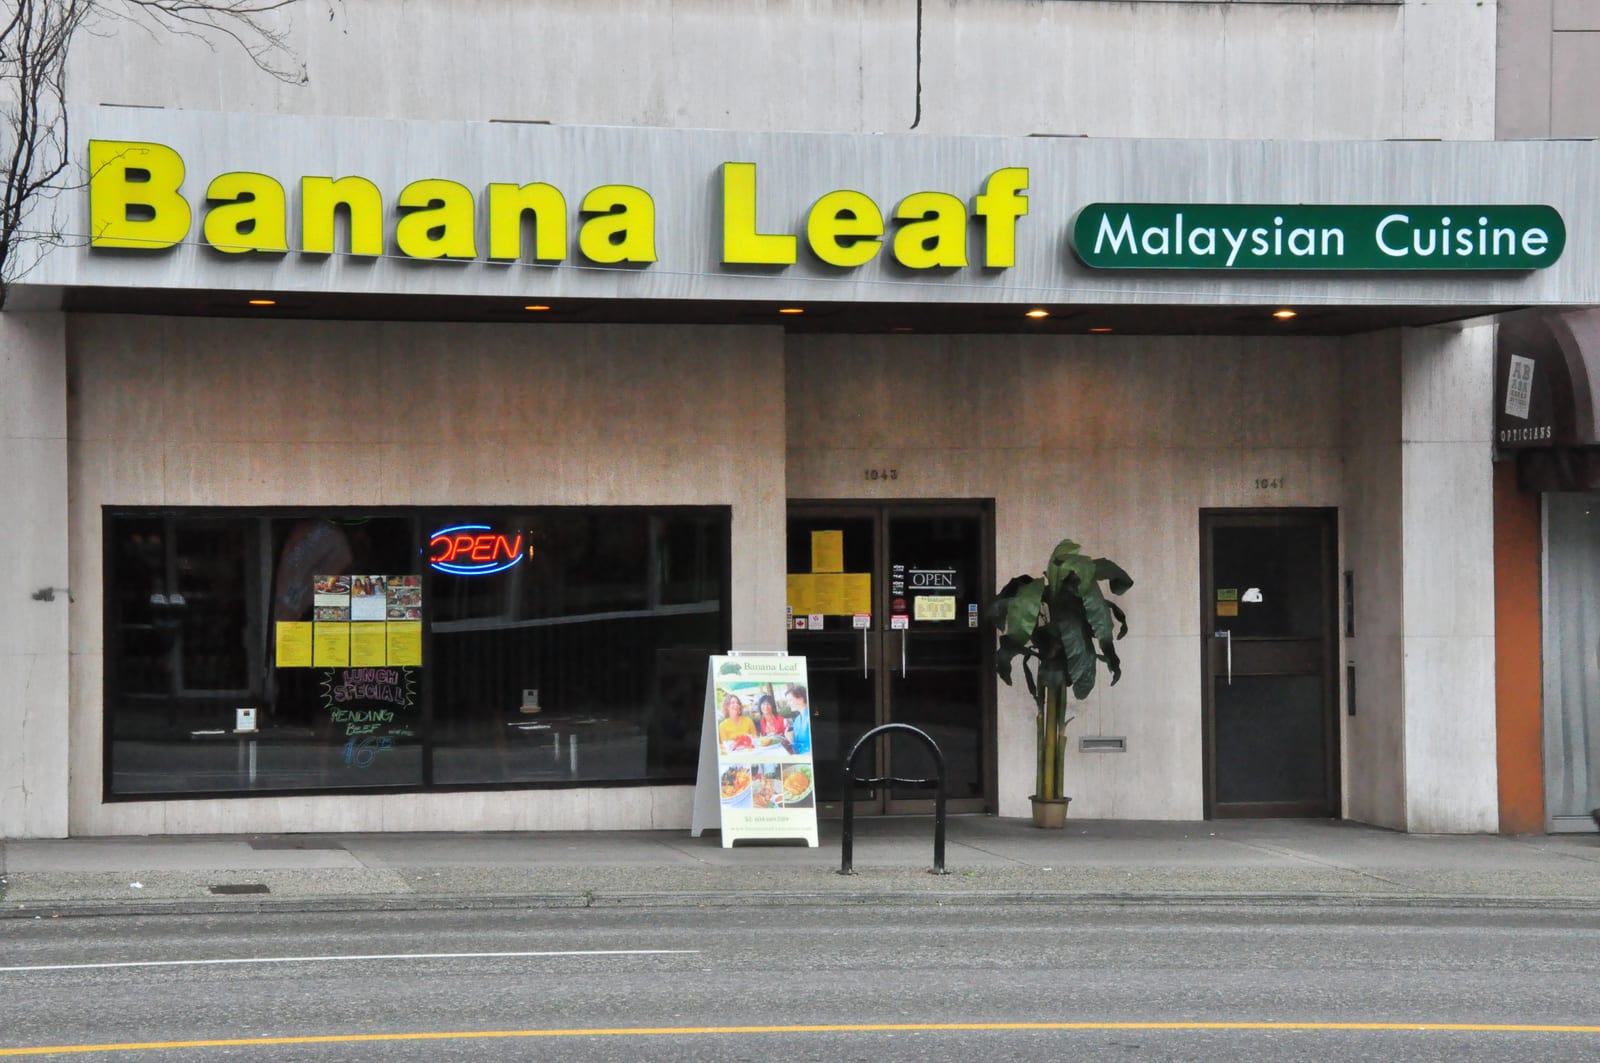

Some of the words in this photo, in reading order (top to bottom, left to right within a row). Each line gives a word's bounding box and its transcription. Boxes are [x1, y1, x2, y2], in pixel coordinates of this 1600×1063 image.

[88, 138, 657, 265] Banana
[720, 161, 1029, 269] Leaf
[1093, 212, 1345, 267] Malaysian
[1375, 213, 1549, 258] Cuisine
[429, 534, 523, 563] OPEN
[912, 573, 953, 586] OPEN
[343, 667, 398, 685] LUNCH
[744, 662, 776, 671] Banana
[779, 663, 798, 672] Leaf
[333, 681, 405, 706] SPECIAL
[345, 722, 382, 736] BEEF
